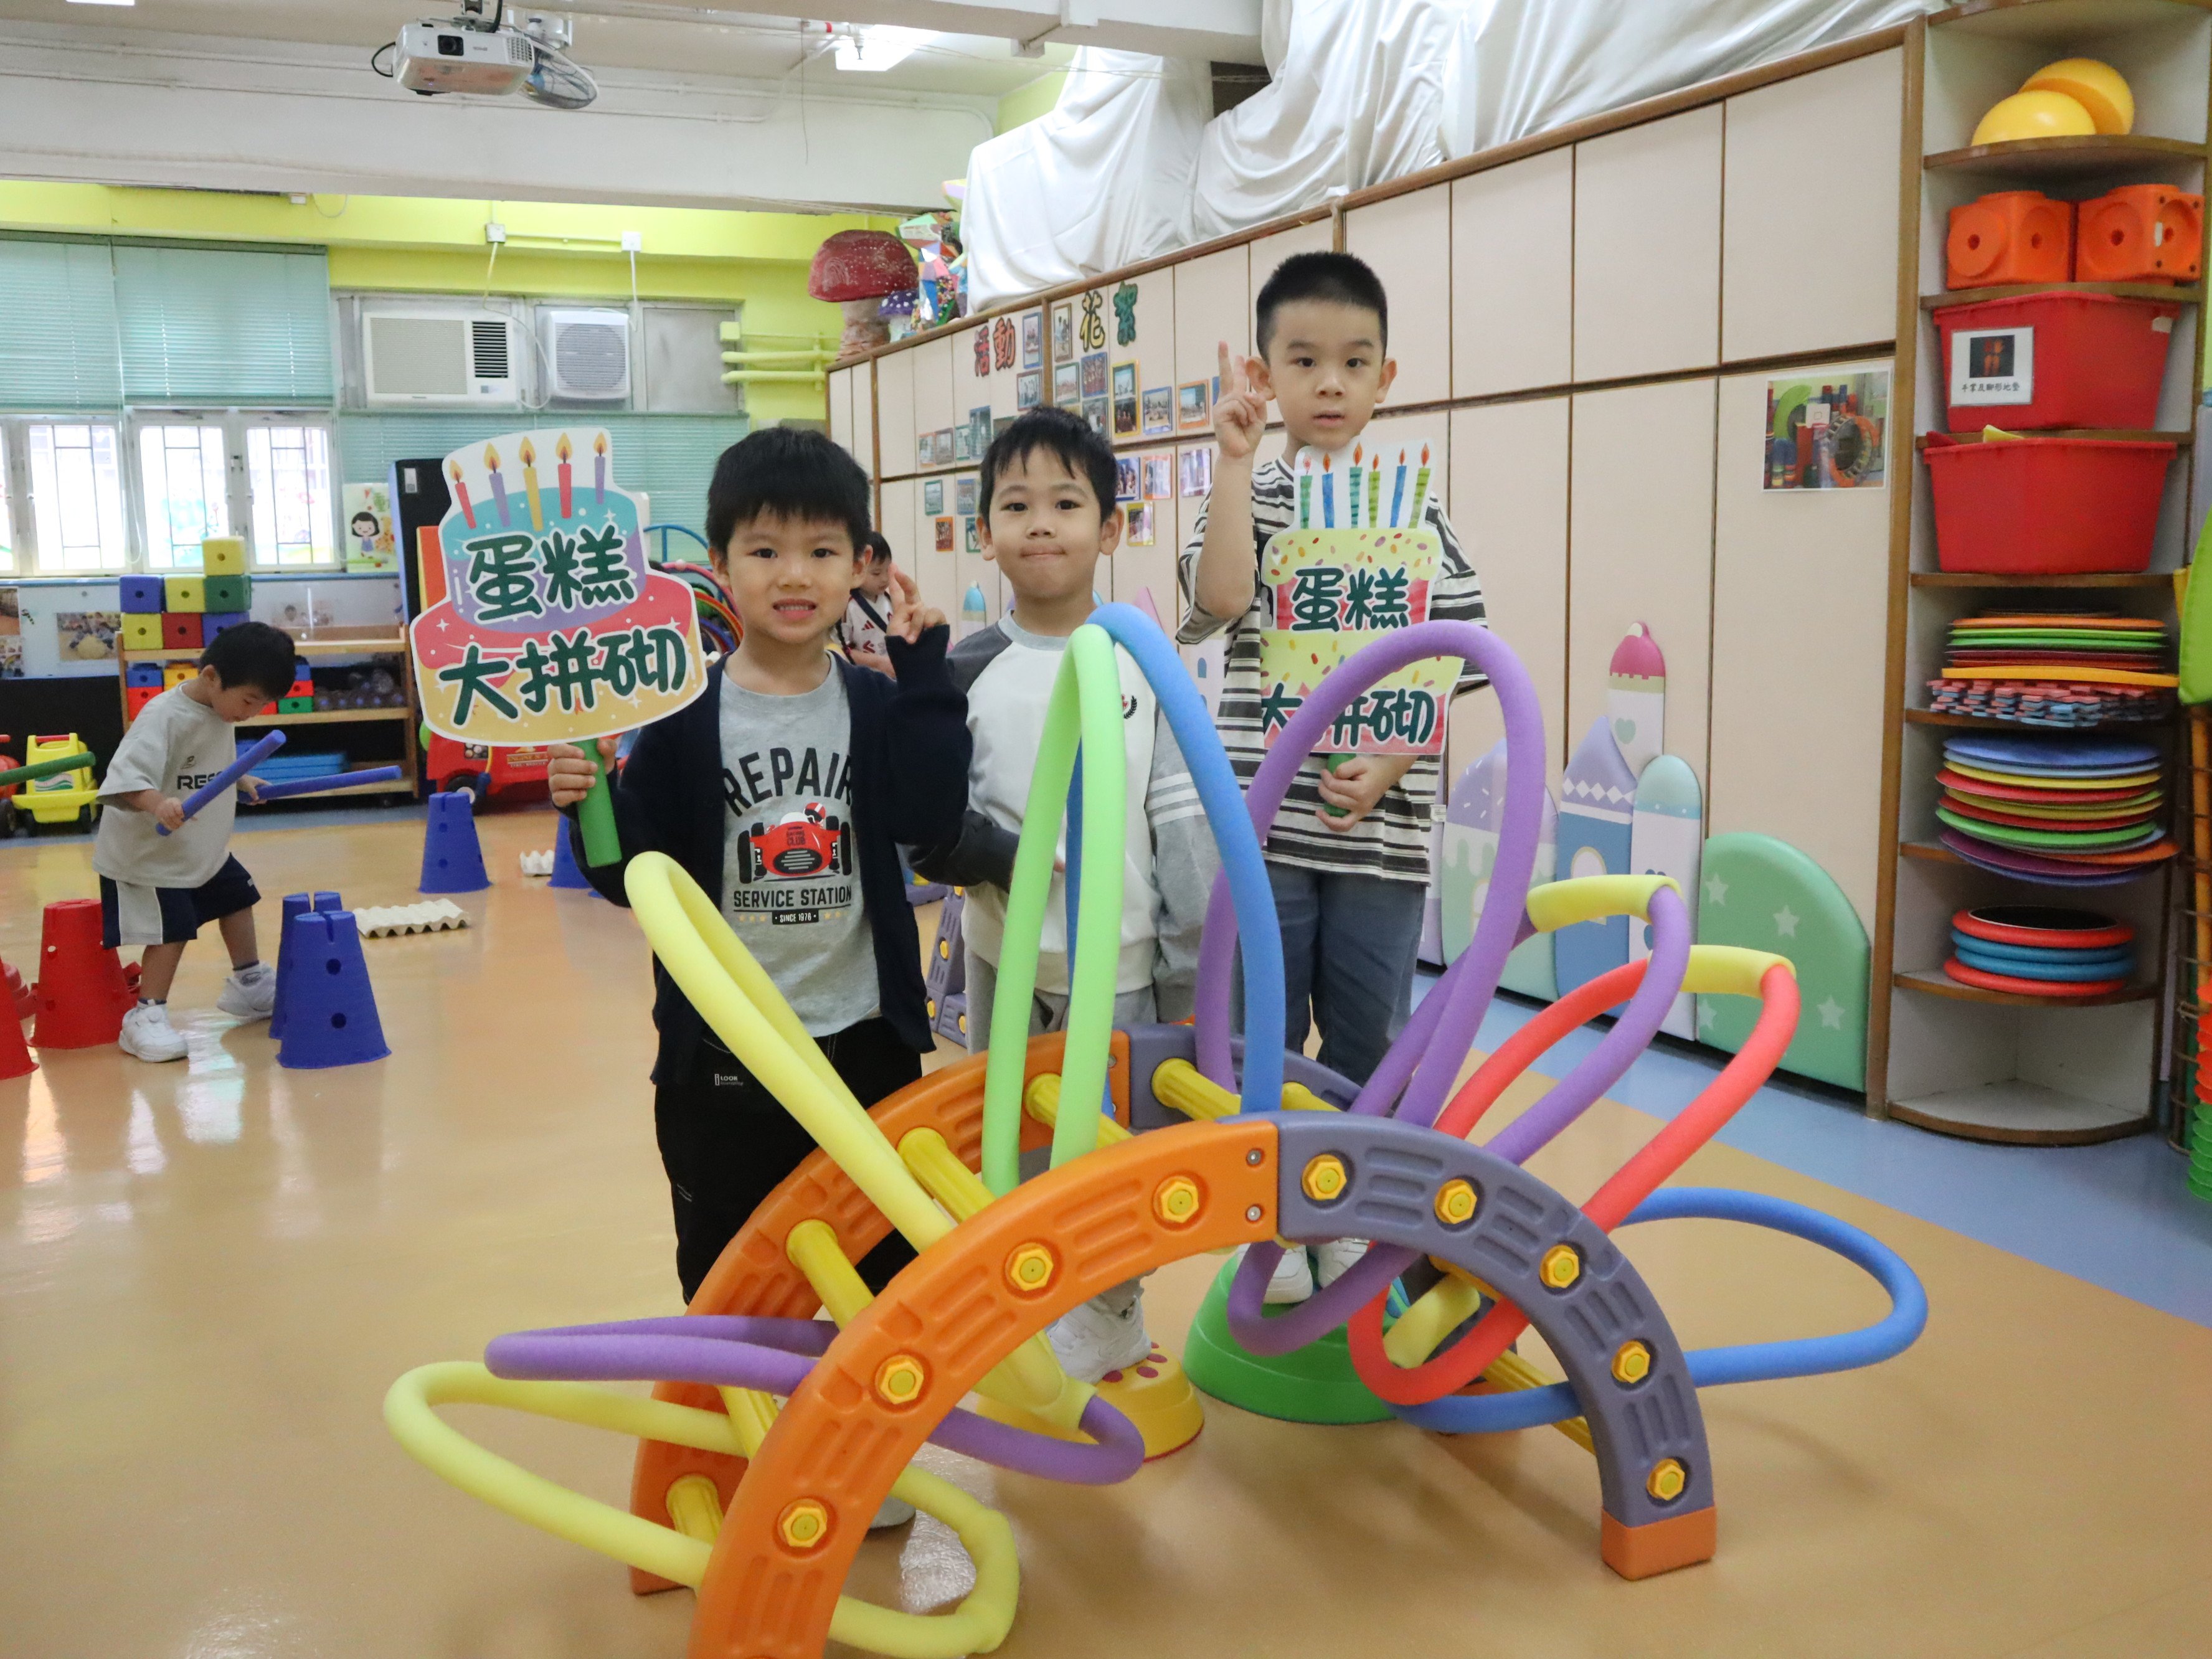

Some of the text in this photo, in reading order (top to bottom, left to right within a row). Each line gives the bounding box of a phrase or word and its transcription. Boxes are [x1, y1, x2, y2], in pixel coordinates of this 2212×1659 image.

[465, 524, 635, 621] 蛋糕
[1291, 567, 1409, 632] 蛋糕
[438, 627, 687, 726] 大拼砌
[734, 885, 852, 908] SERVICE STATION
[780, 914, 796, 923] SINCE
